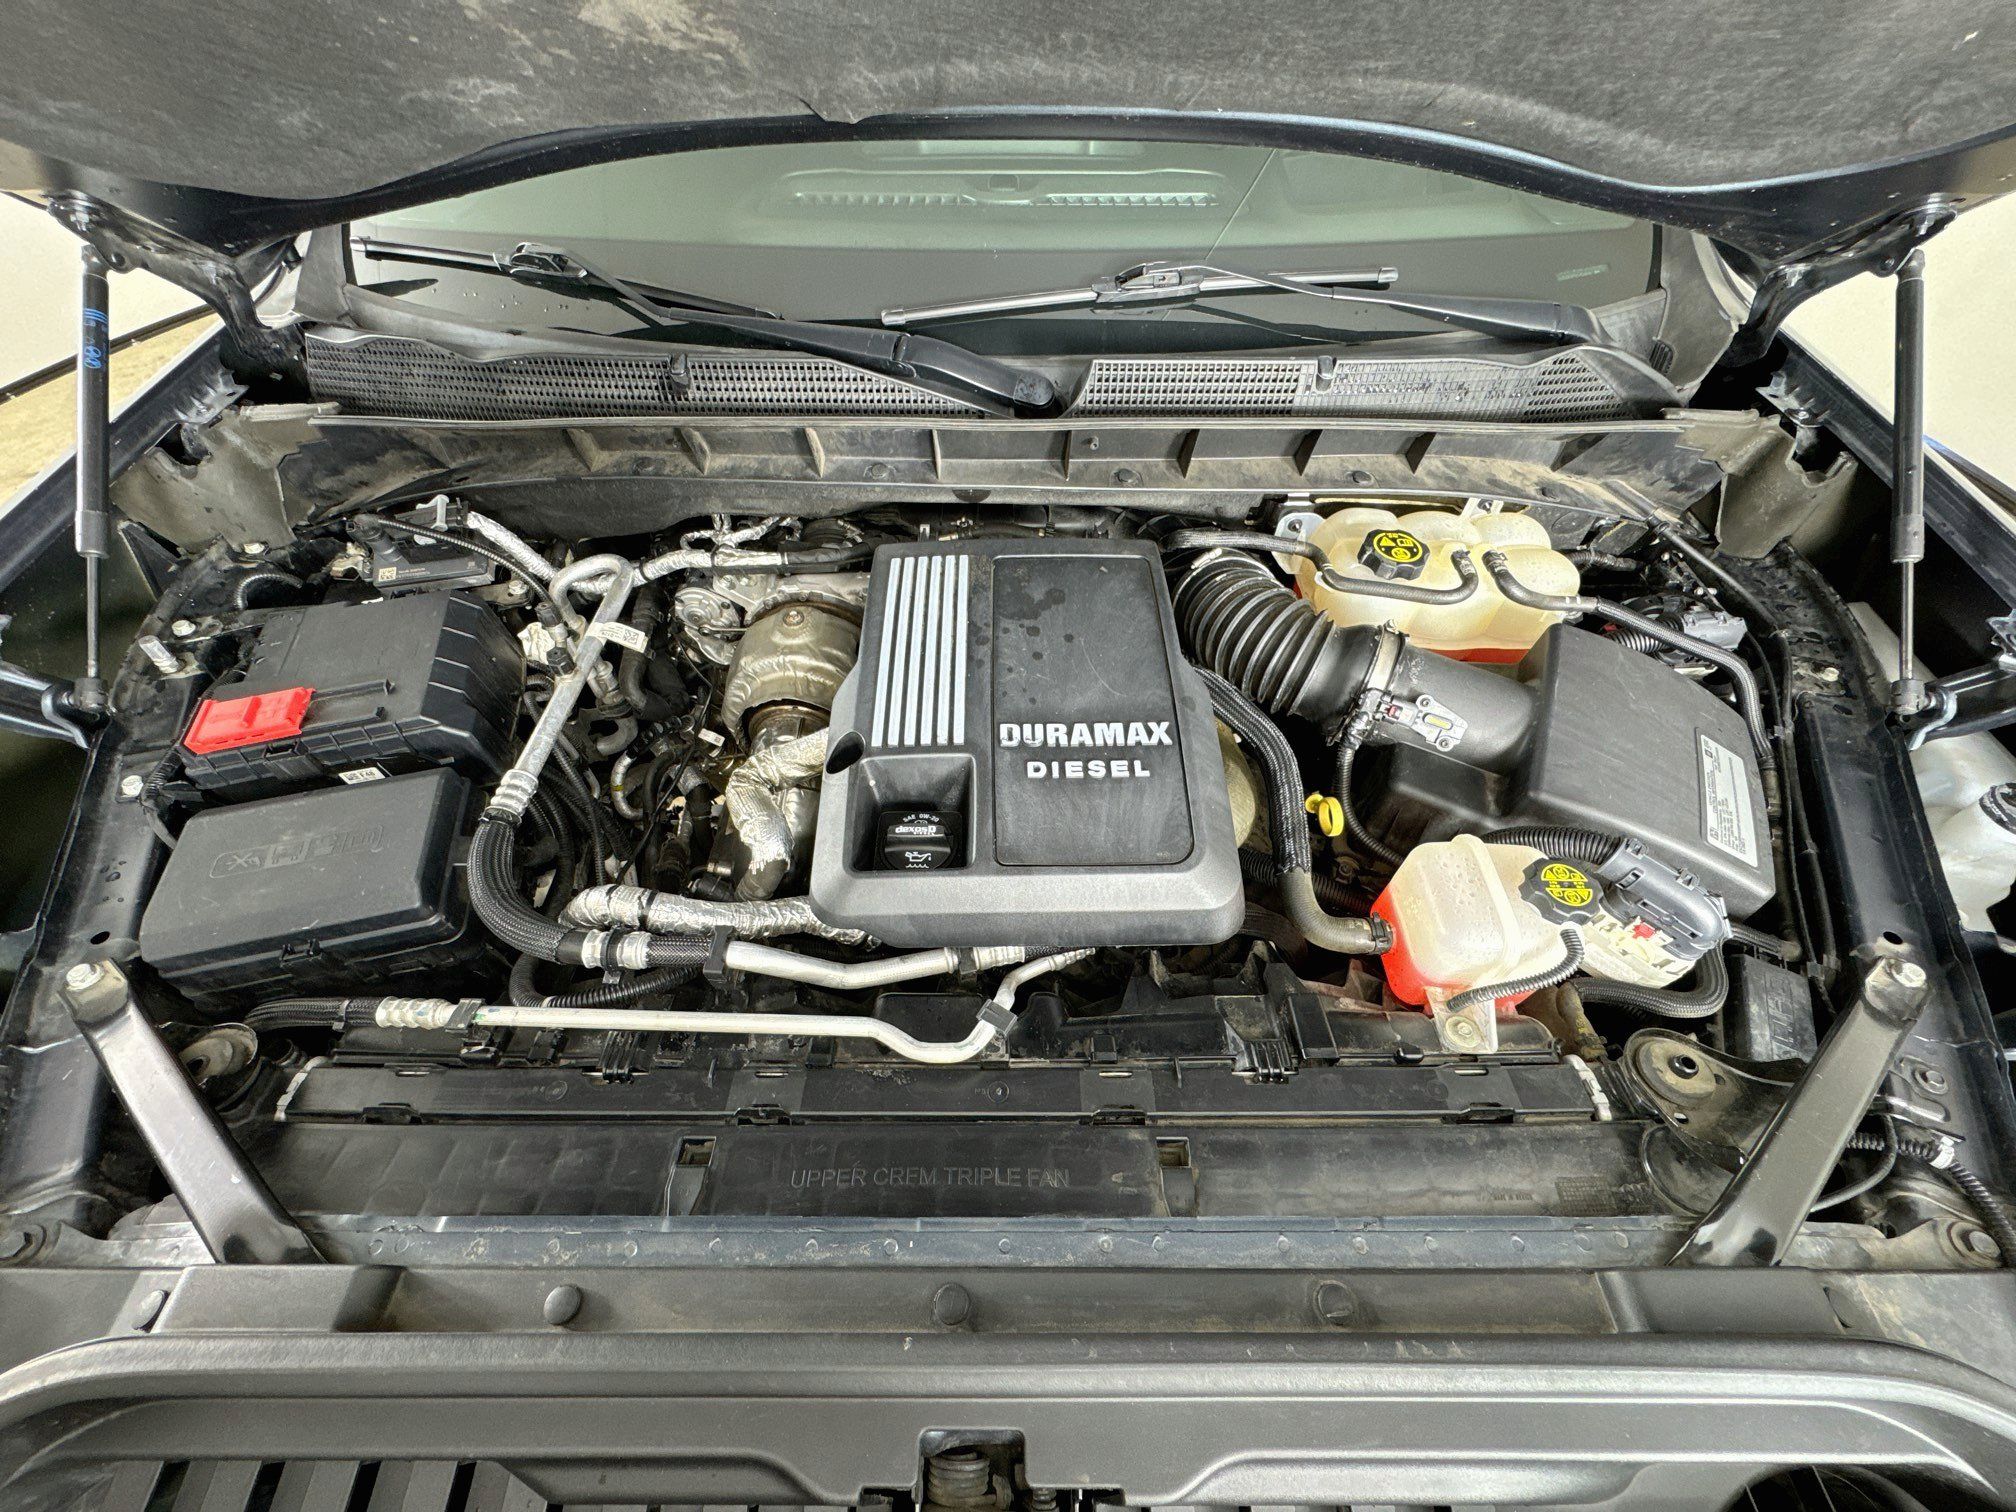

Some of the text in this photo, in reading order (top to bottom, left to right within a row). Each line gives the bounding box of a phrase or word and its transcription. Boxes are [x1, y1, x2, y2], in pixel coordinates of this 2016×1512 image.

[999, 721, 1173, 748] DURAMAX
[1026, 759, 1150, 779] DIESEL
[903, 814, 916, 822] SAE
[791, 1163, 866, 1188] UPPER
[943, 1166, 1022, 1187] TRIPLE
[1027, 1167, 1070, 1188] FAN
